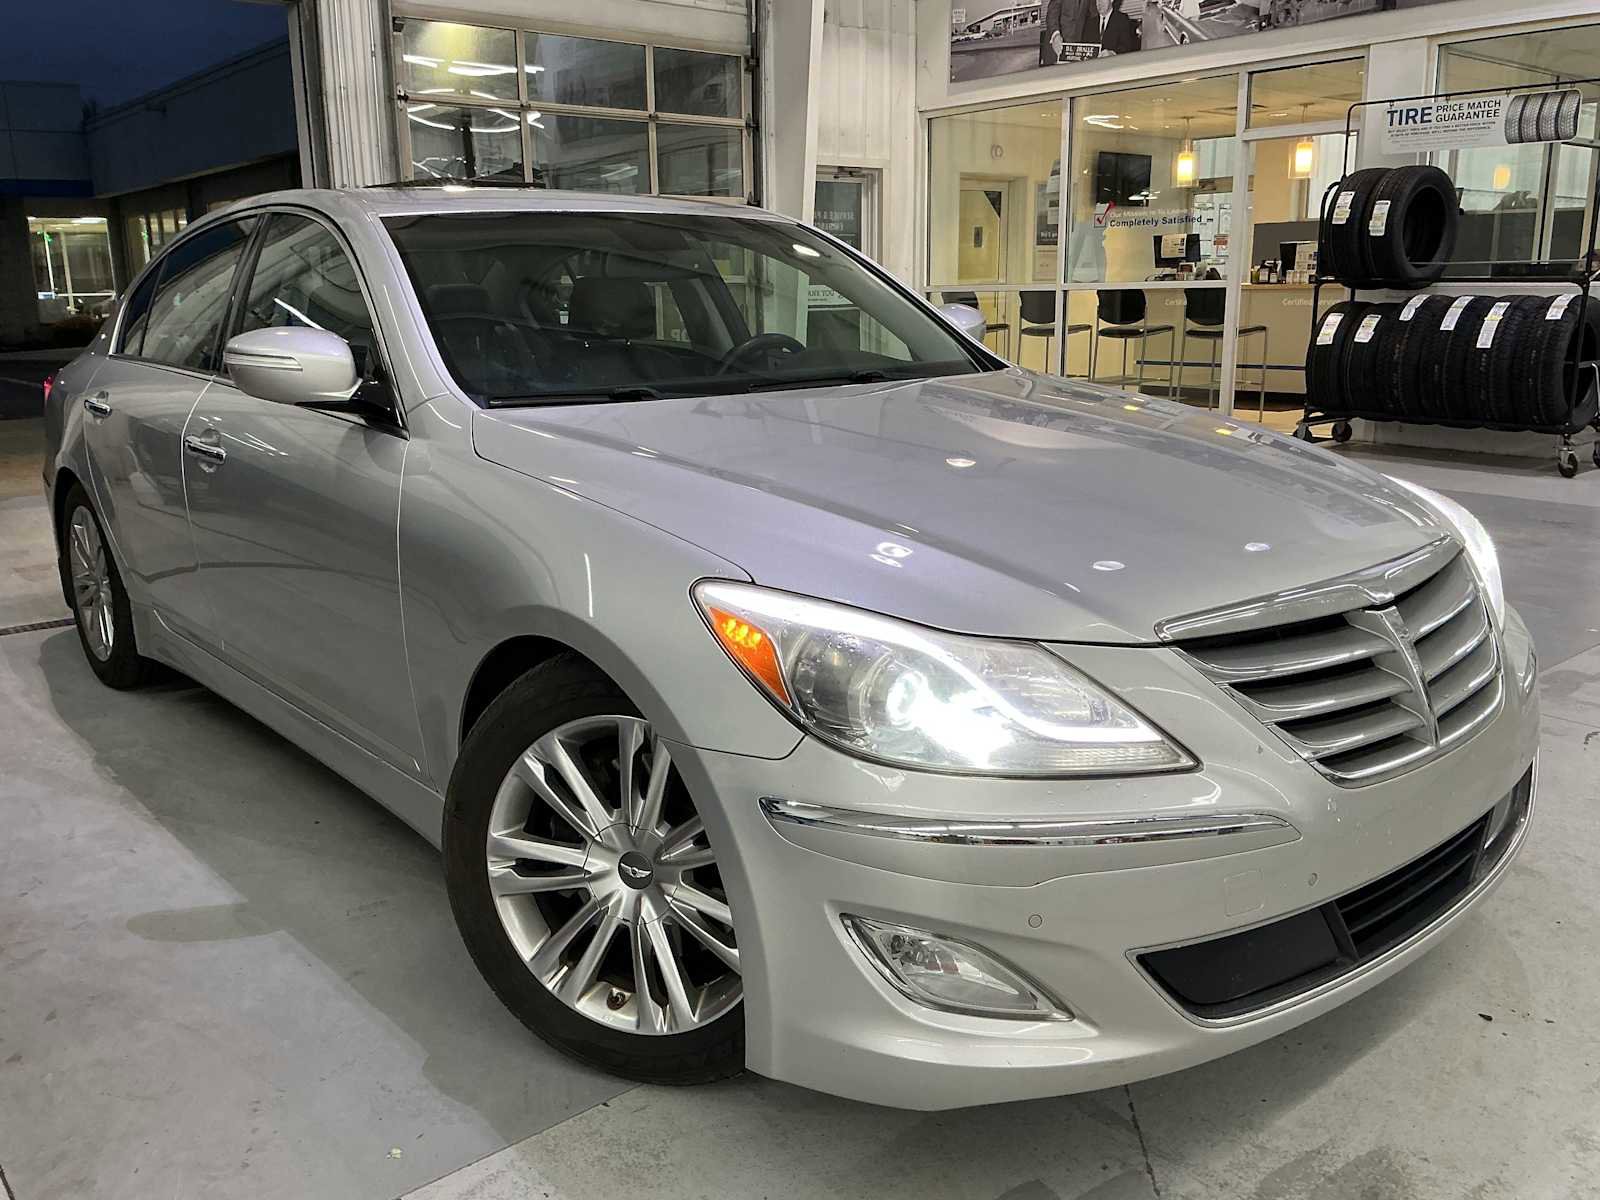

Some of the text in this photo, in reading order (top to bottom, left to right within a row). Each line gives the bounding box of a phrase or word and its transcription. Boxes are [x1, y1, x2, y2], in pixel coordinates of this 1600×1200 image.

[1387, 100, 1501, 126] TIRE PRICE MATCH
[1436, 109, 1499, 122] GUARANTEE
[1110, 215, 1202, 228] Completely Satisfied
